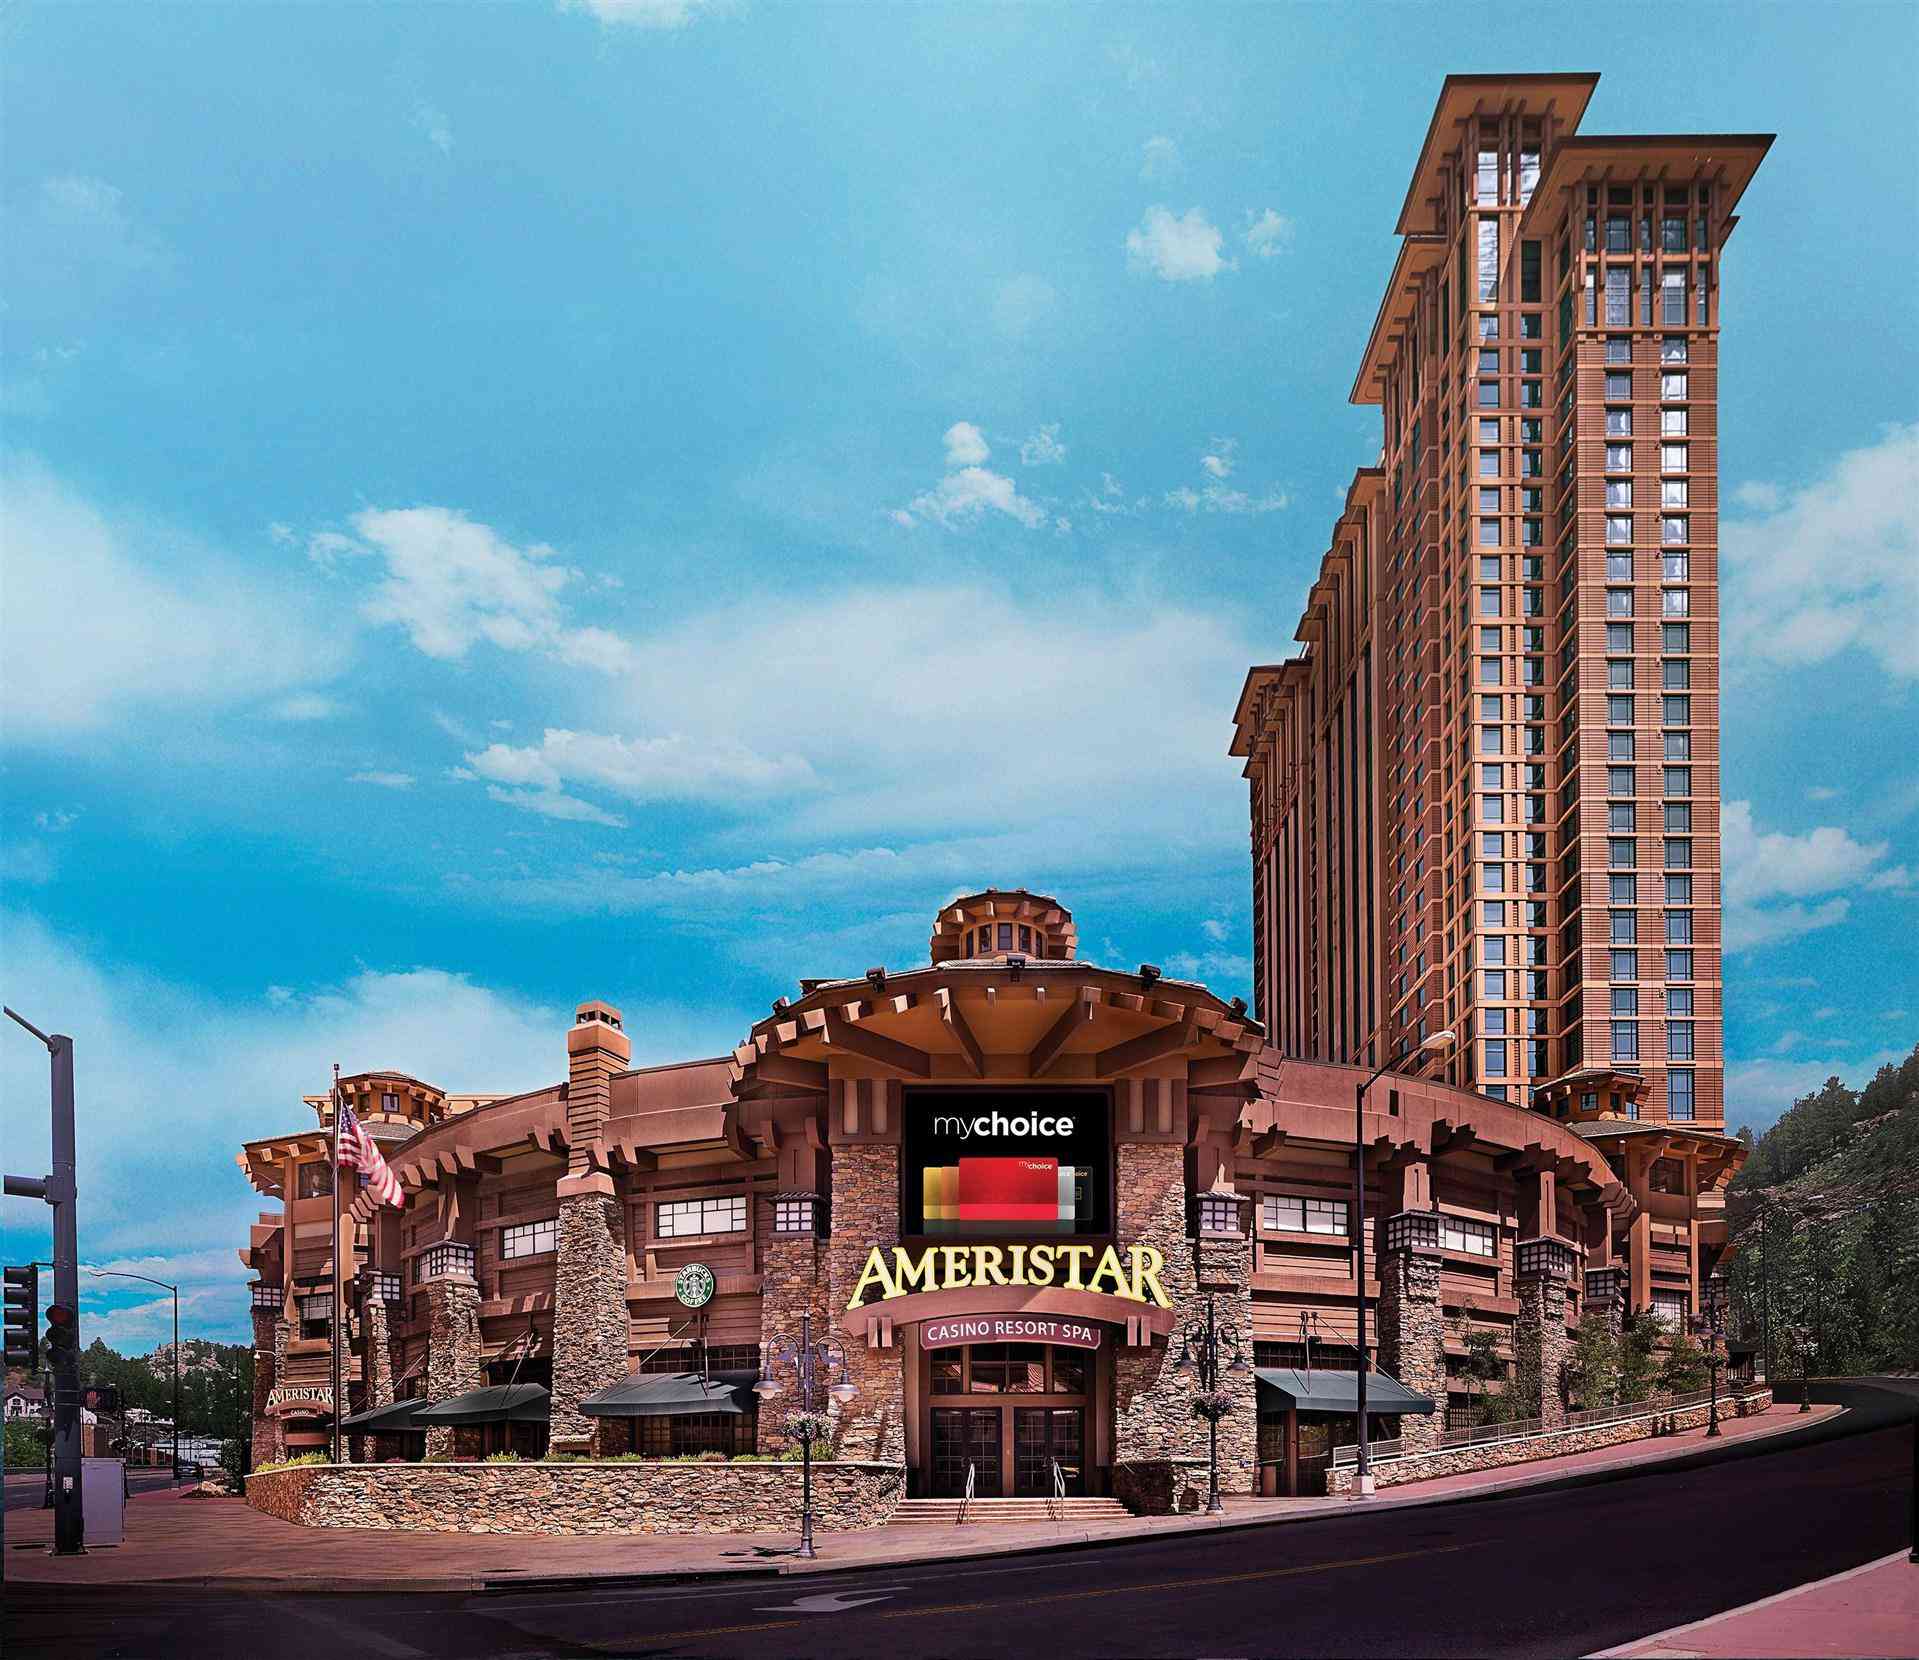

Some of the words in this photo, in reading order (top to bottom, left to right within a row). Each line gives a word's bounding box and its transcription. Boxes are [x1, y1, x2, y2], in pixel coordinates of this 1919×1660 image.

[934, 1111, 1074, 1140] mychoice
[1018, 1161, 1053, 1170] mychoice
[678, 1265, 711, 1283] STARBUCKS
[847, 1245, 1174, 1309] AMERISTAR
[681, 1295, 706, 1305] COFFEE
[928, 1321, 989, 1341] CASINO
[995, 1321, 1057, 1336] RESORT
[1062, 1324, 1092, 1341] SPA
[266, 1387, 334, 1408] AMERISTAR
